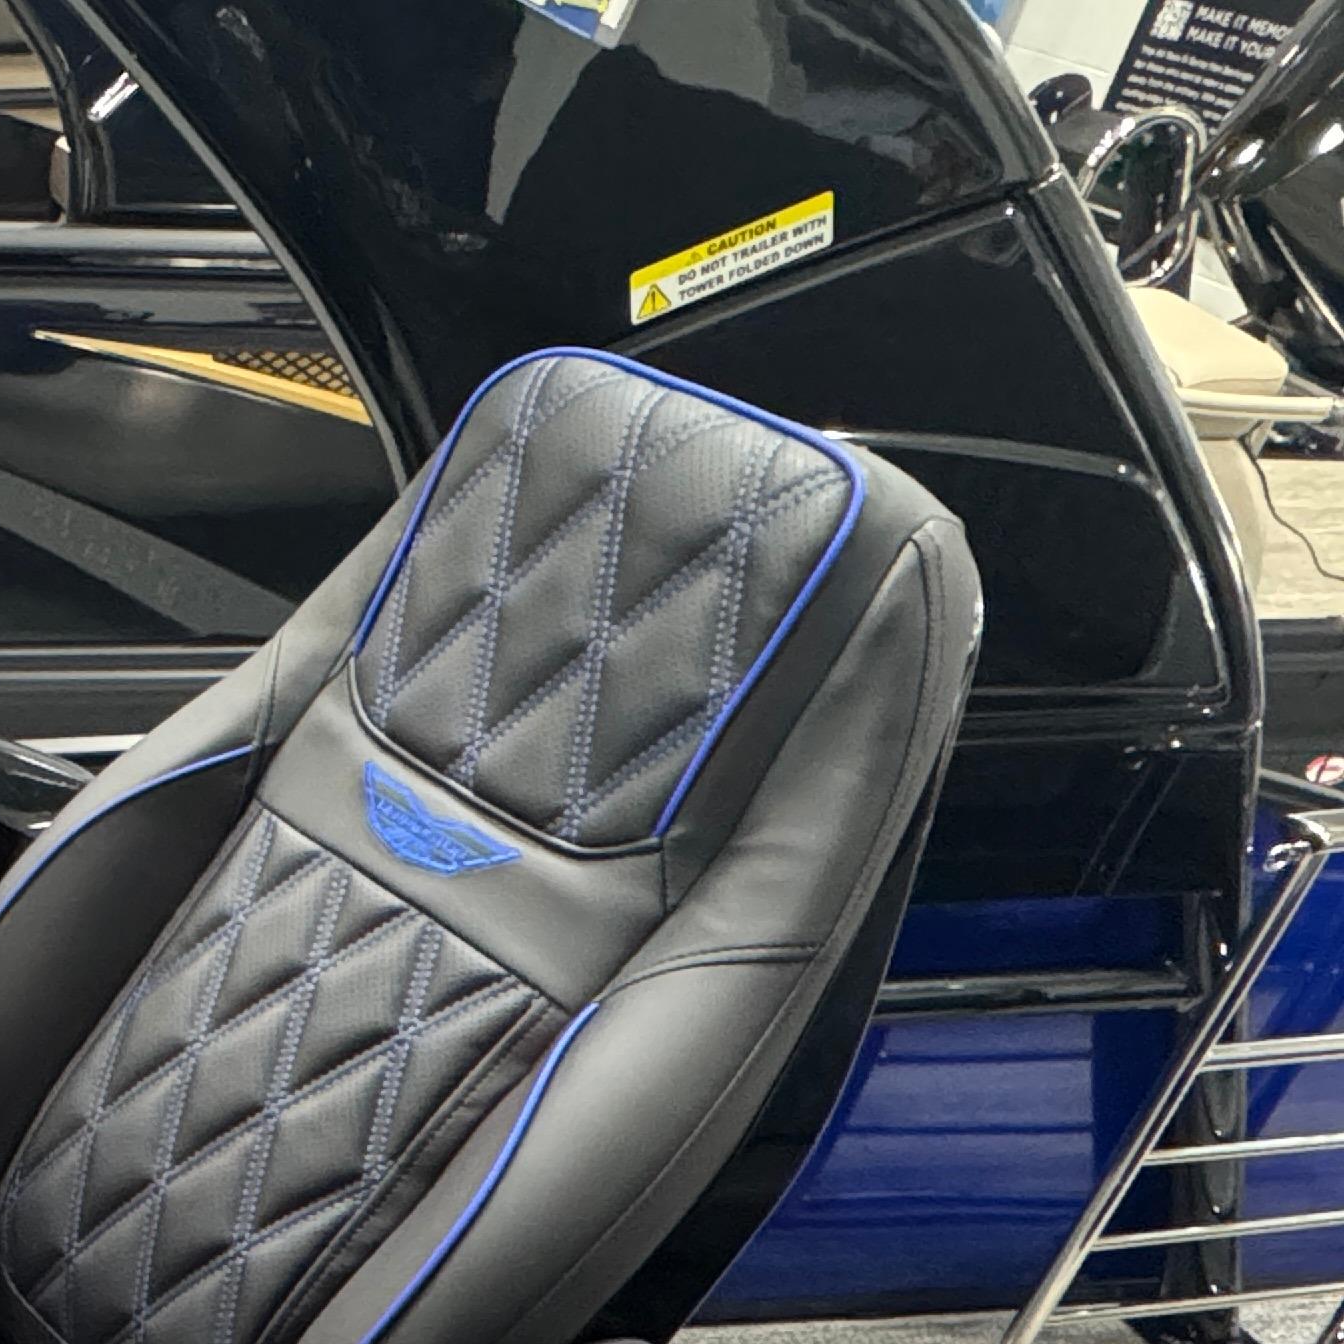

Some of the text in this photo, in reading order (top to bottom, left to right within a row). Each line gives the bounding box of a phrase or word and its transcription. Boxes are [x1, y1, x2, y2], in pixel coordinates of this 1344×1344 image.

[1195, 5, 1234, 28] MAKE
[1232, 14, 1249, 31] IT
[1185, 26, 1224, 49] MAKE
[1223, 35, 1240, 51] IT
[678, 215, 828, 286] DO NOT TRAILER WITH
[707, 218, 777, 256] CAUTION
[678, 233, 825, 302] TOWER FOLDED DOWN
